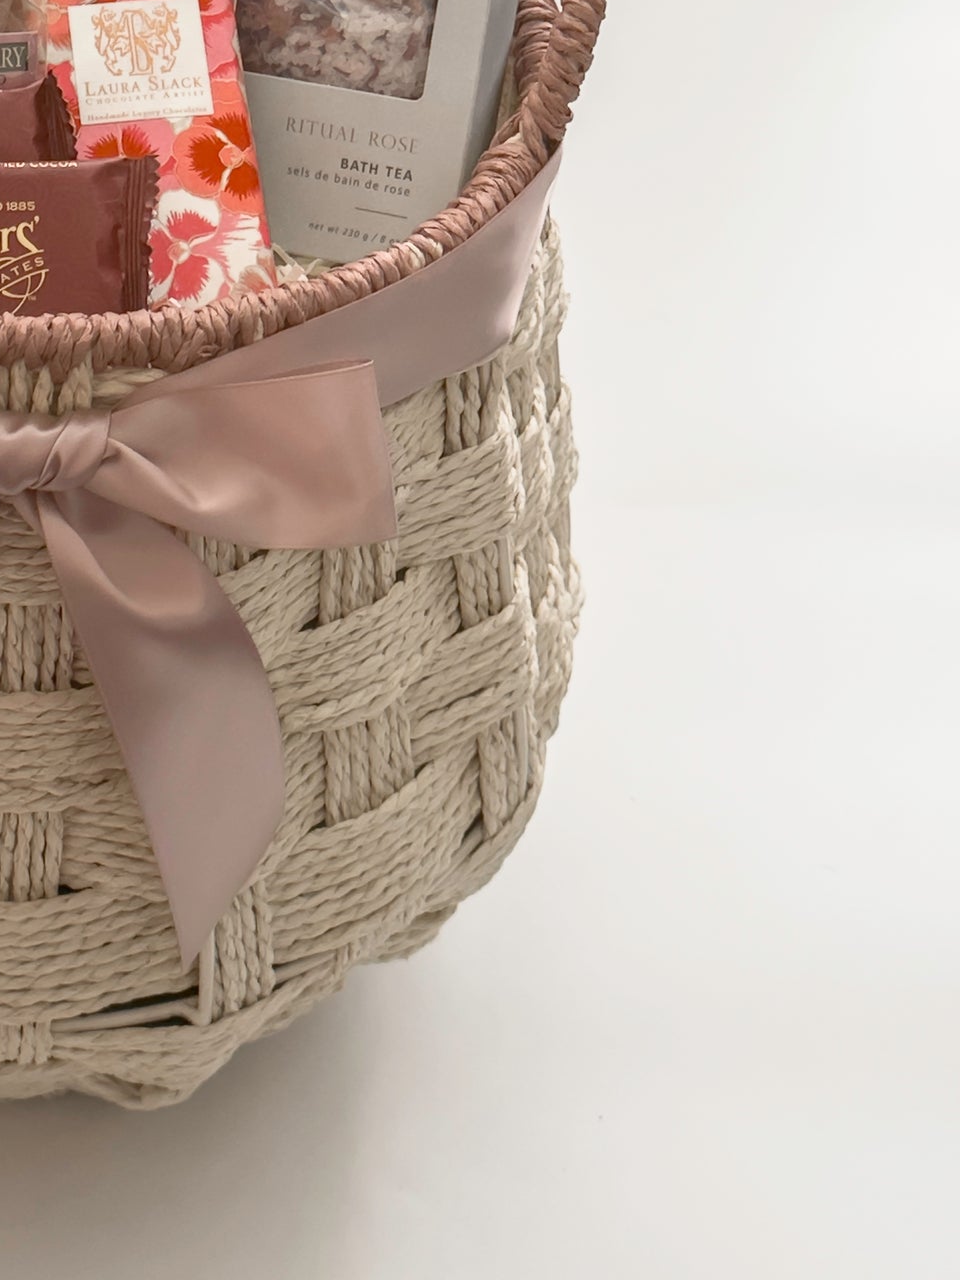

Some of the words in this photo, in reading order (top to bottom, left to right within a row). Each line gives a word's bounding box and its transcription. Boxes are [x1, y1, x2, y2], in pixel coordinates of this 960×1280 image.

[84, 81, 141, 97] LAURA
[148, 75, 203, 92] SLACK
[285, 117, 358, 143] RITUAL
[368, 131, 420, 154] ROSE
[340, 158, 379, 175] BATH
[386, 166, 414, 181] TEA
[287, 166, 310, 178] sels
[314, 170, 329, 182] de
[334, 173, 360, 187] bain
[365, 179, 379, 191] de
[384, 185, 411, 197] rose
[6, 200, 36, 212] 1885
